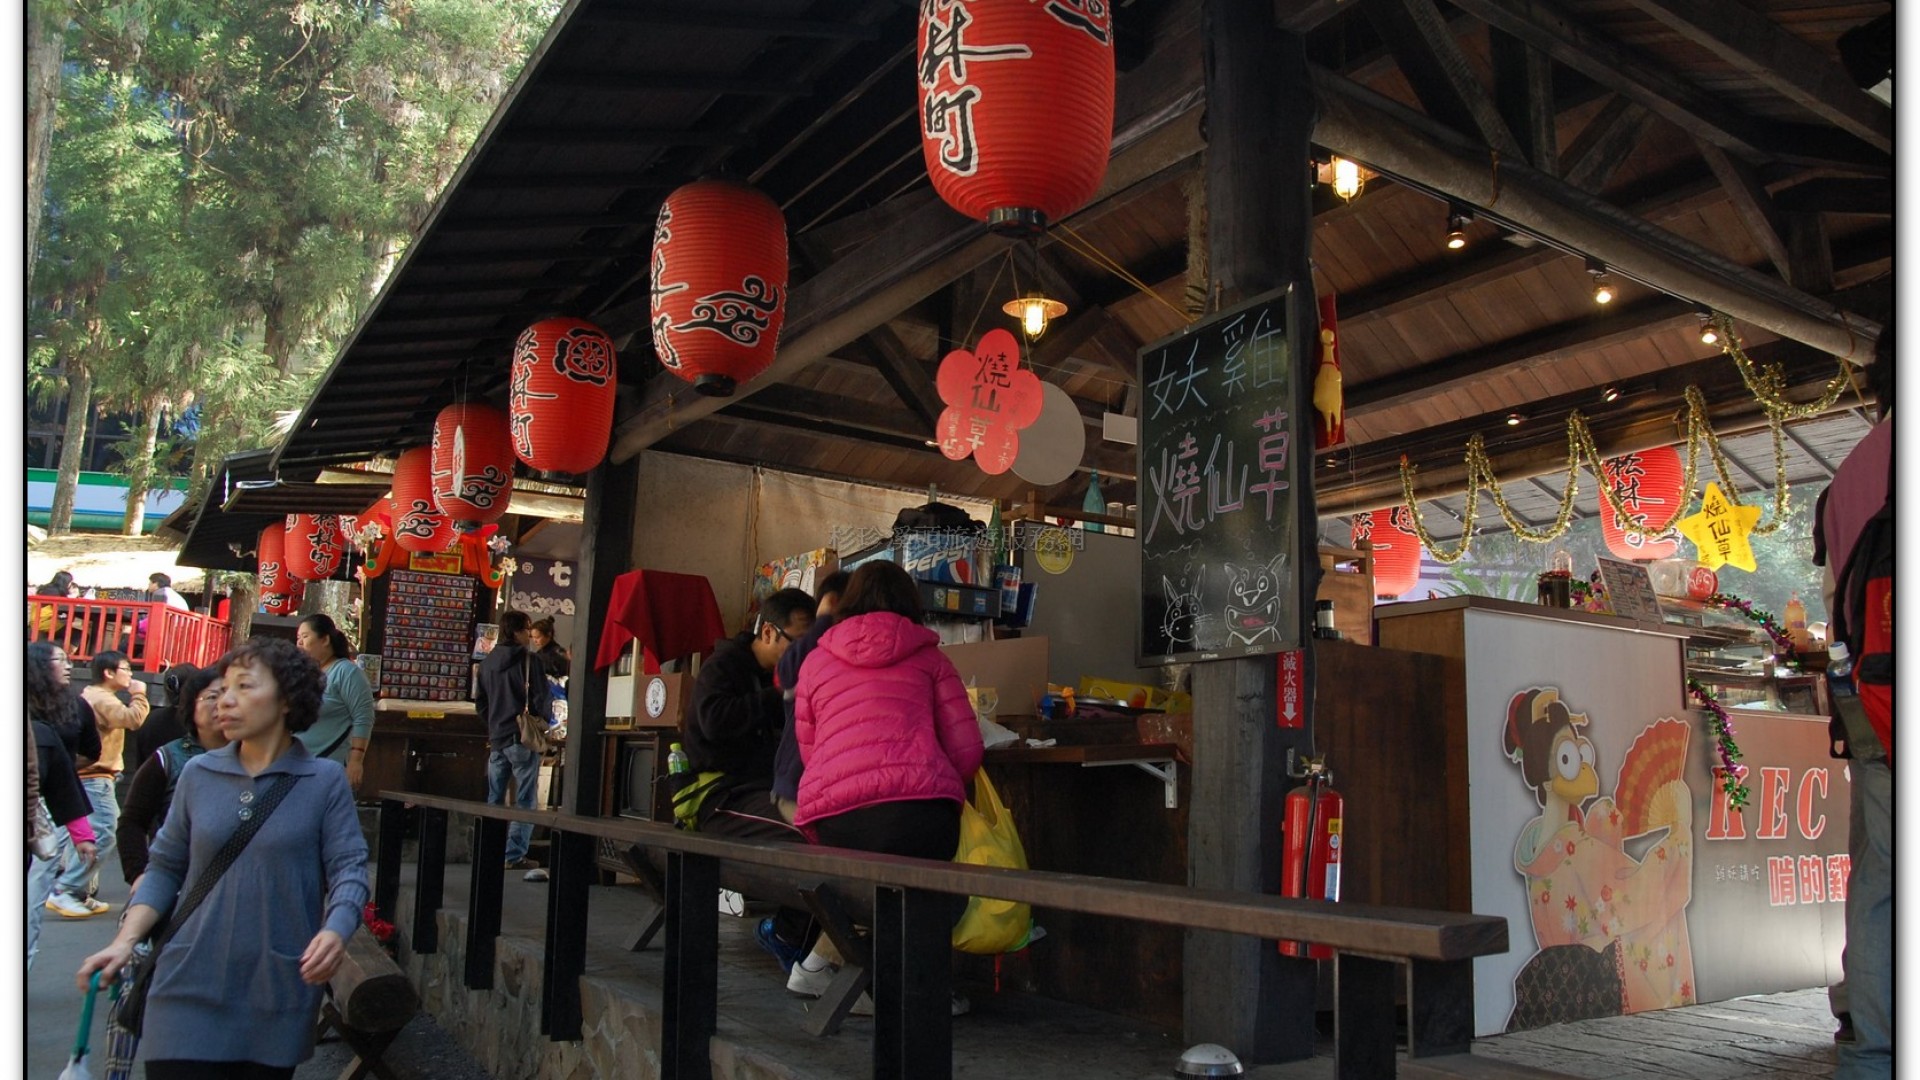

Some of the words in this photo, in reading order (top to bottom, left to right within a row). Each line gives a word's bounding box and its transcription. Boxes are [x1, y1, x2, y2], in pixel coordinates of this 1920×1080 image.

[919, 0, 1033, 177] 林町
[965, 352, 1011, 451] 燒仙草
[1147, 308, 1283, 420] 妖雞
[1144, 405, 1290, 545] 燒仙草
[1703, 495, 1732, 561] 燒仙草
[548, 560, 572, 588] 七
[1282, 652, 1297, 703] 滅火器
[1705, 765, 1829, 840] KEC
